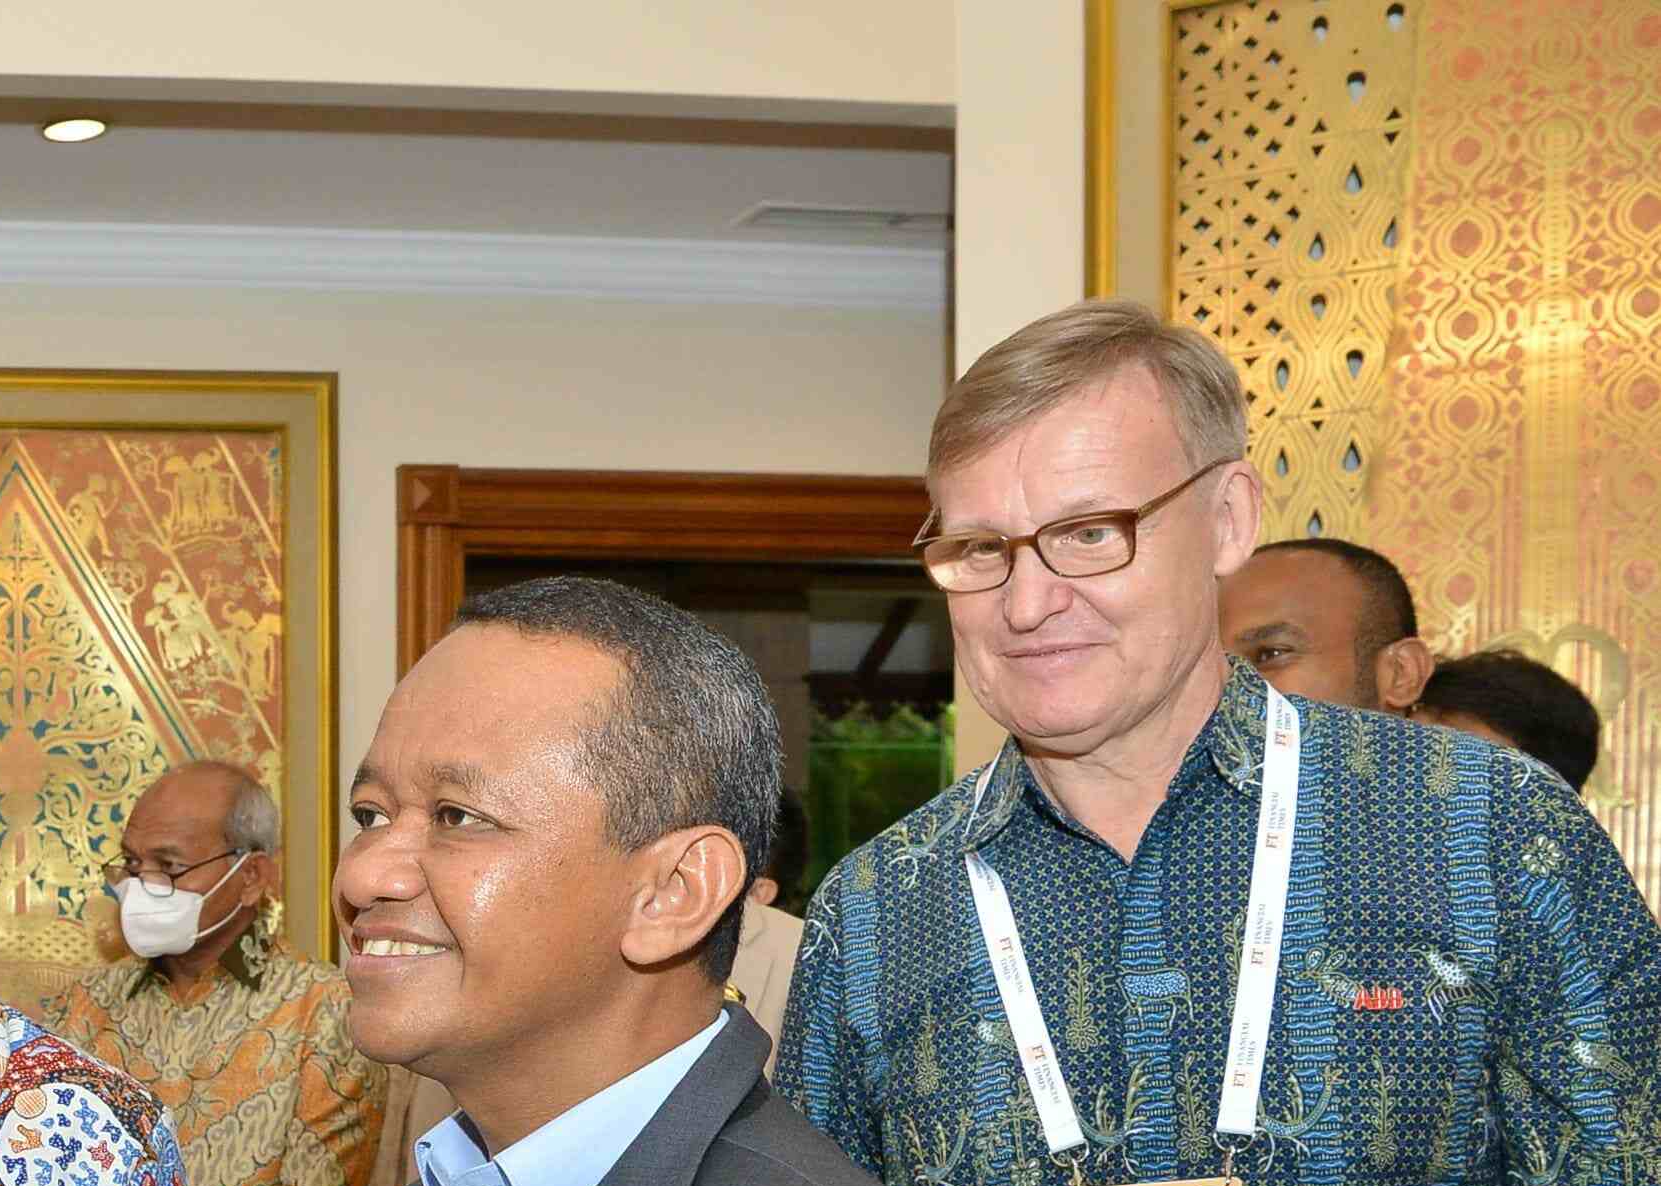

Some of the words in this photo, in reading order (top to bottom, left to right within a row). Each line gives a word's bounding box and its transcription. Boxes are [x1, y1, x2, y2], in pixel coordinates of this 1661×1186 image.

[1266, 833, 1279, 849] FT
[1000, 936, 1014, 952] FT
[1251, 948, 1264, 965] FT
[1032, 1044, 1046, 1060] FT
[1233, 1069, 1246, 1088] FT
